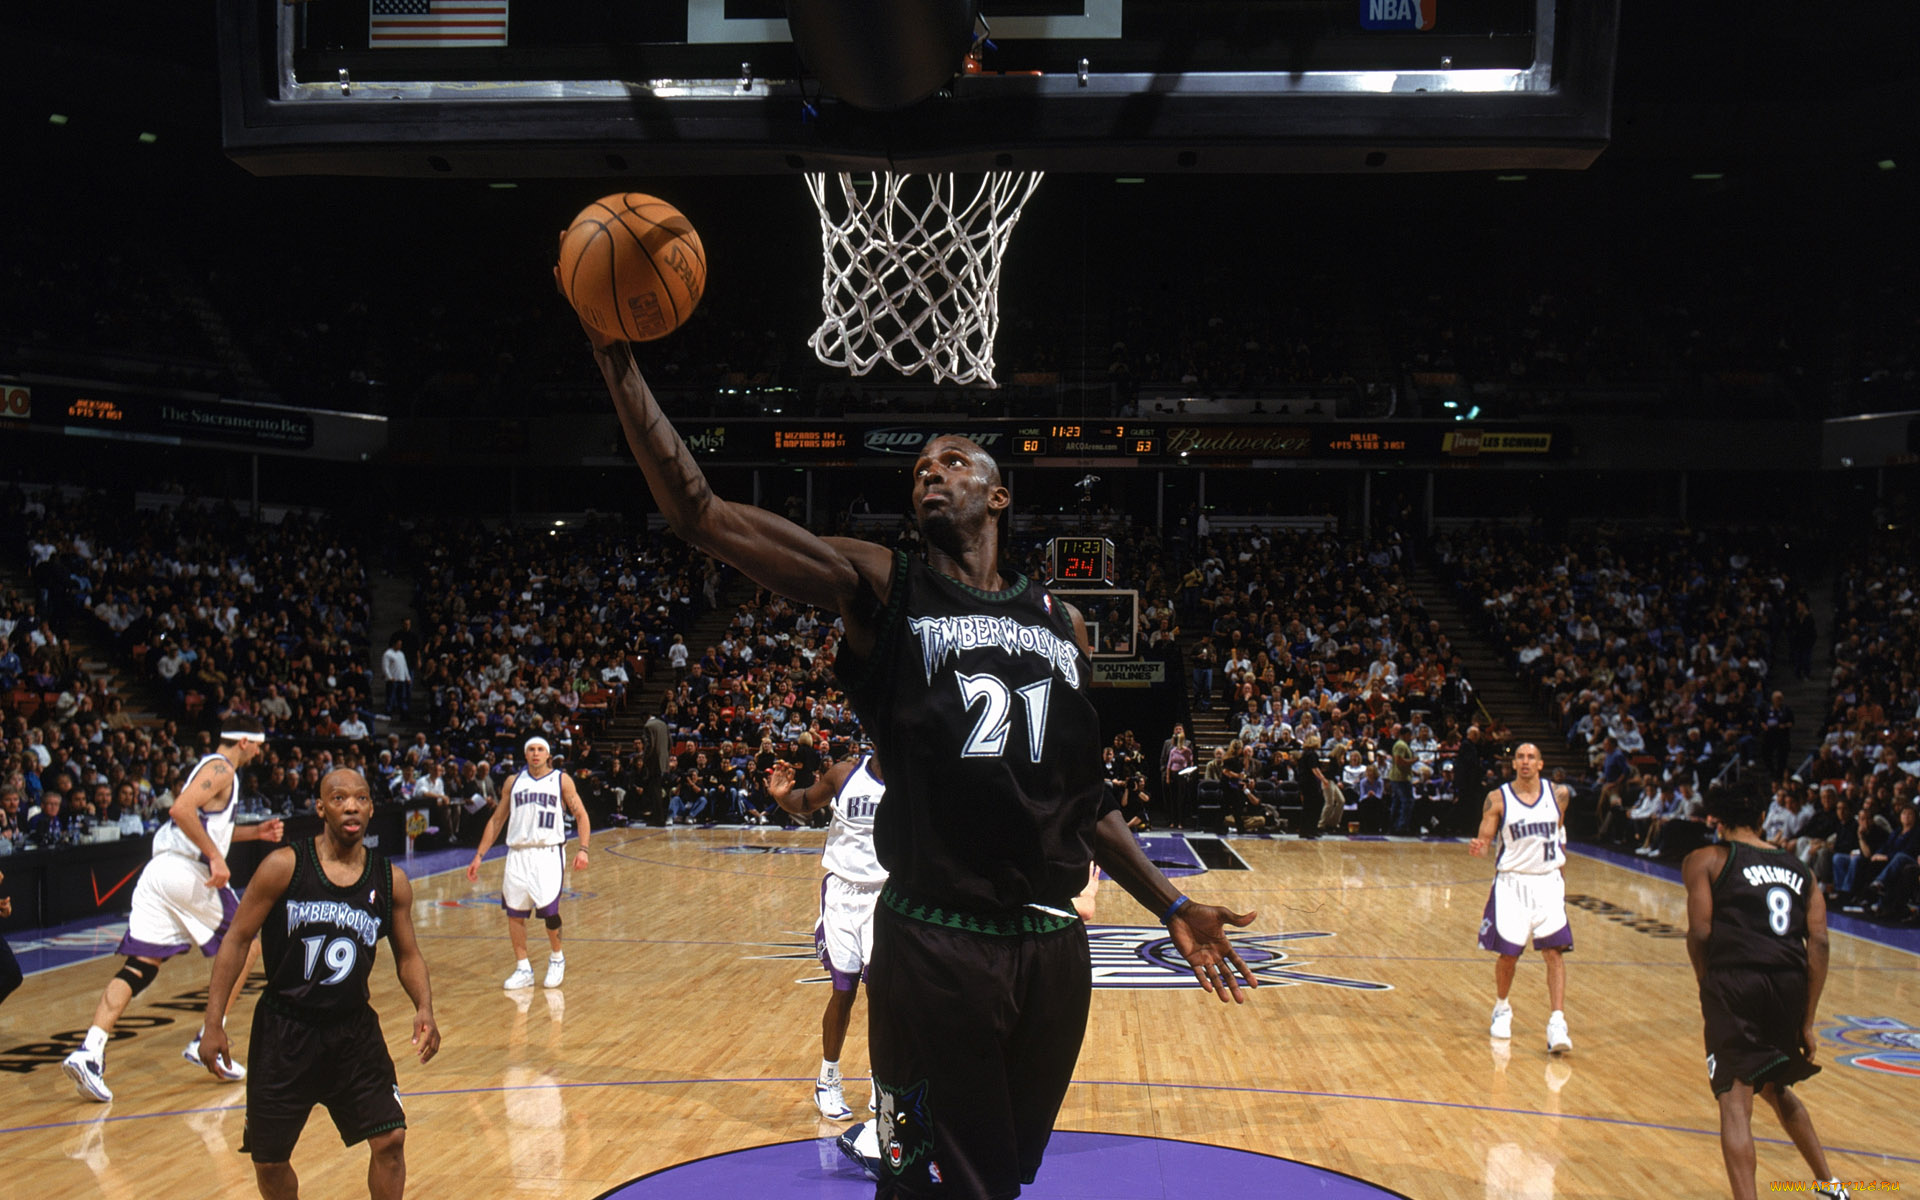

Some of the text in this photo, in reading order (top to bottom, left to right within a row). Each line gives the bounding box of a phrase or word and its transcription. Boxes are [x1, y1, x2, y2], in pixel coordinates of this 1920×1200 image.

[1369, 0, 1412, 21] NBA
[160, 404, 189, 421] The
[190, 407, 278, 430] Sacramento
[867, 433, 924, 446] BUD
[1019, 428, 1041, 436] HOME
[1052, 426, 1081, 438] 11:23
[1115, 426, 1125, 438] 3
[1130, 428, 1155, 436] GUEST
[1166, 428, 1310, 452] Budweiser
[1023, 440, 1039, 452] 60
[1483, 437, 1499, 447] LES
[1063, 541, 1101, 554] 11:23
[1065, 557, 1094, 577] 24
[907, 615, 1080, 689] TIMBERWOLVES
[1097, 664, 1160, 672] SOUTHWEST
[1105, 672, 1151, 680] AIRLINES
[954, 670, 1053, 763] 21
[515, 788, 557, 808] Kings
[538, 811, 555, 829] 10
[1543, 841, 1556, 862] 13
[1766, 886, 1792, 936] 8
[287, 900, 382, 947] TIMBERWOLVES
[301, 935, 357, 985] 19
